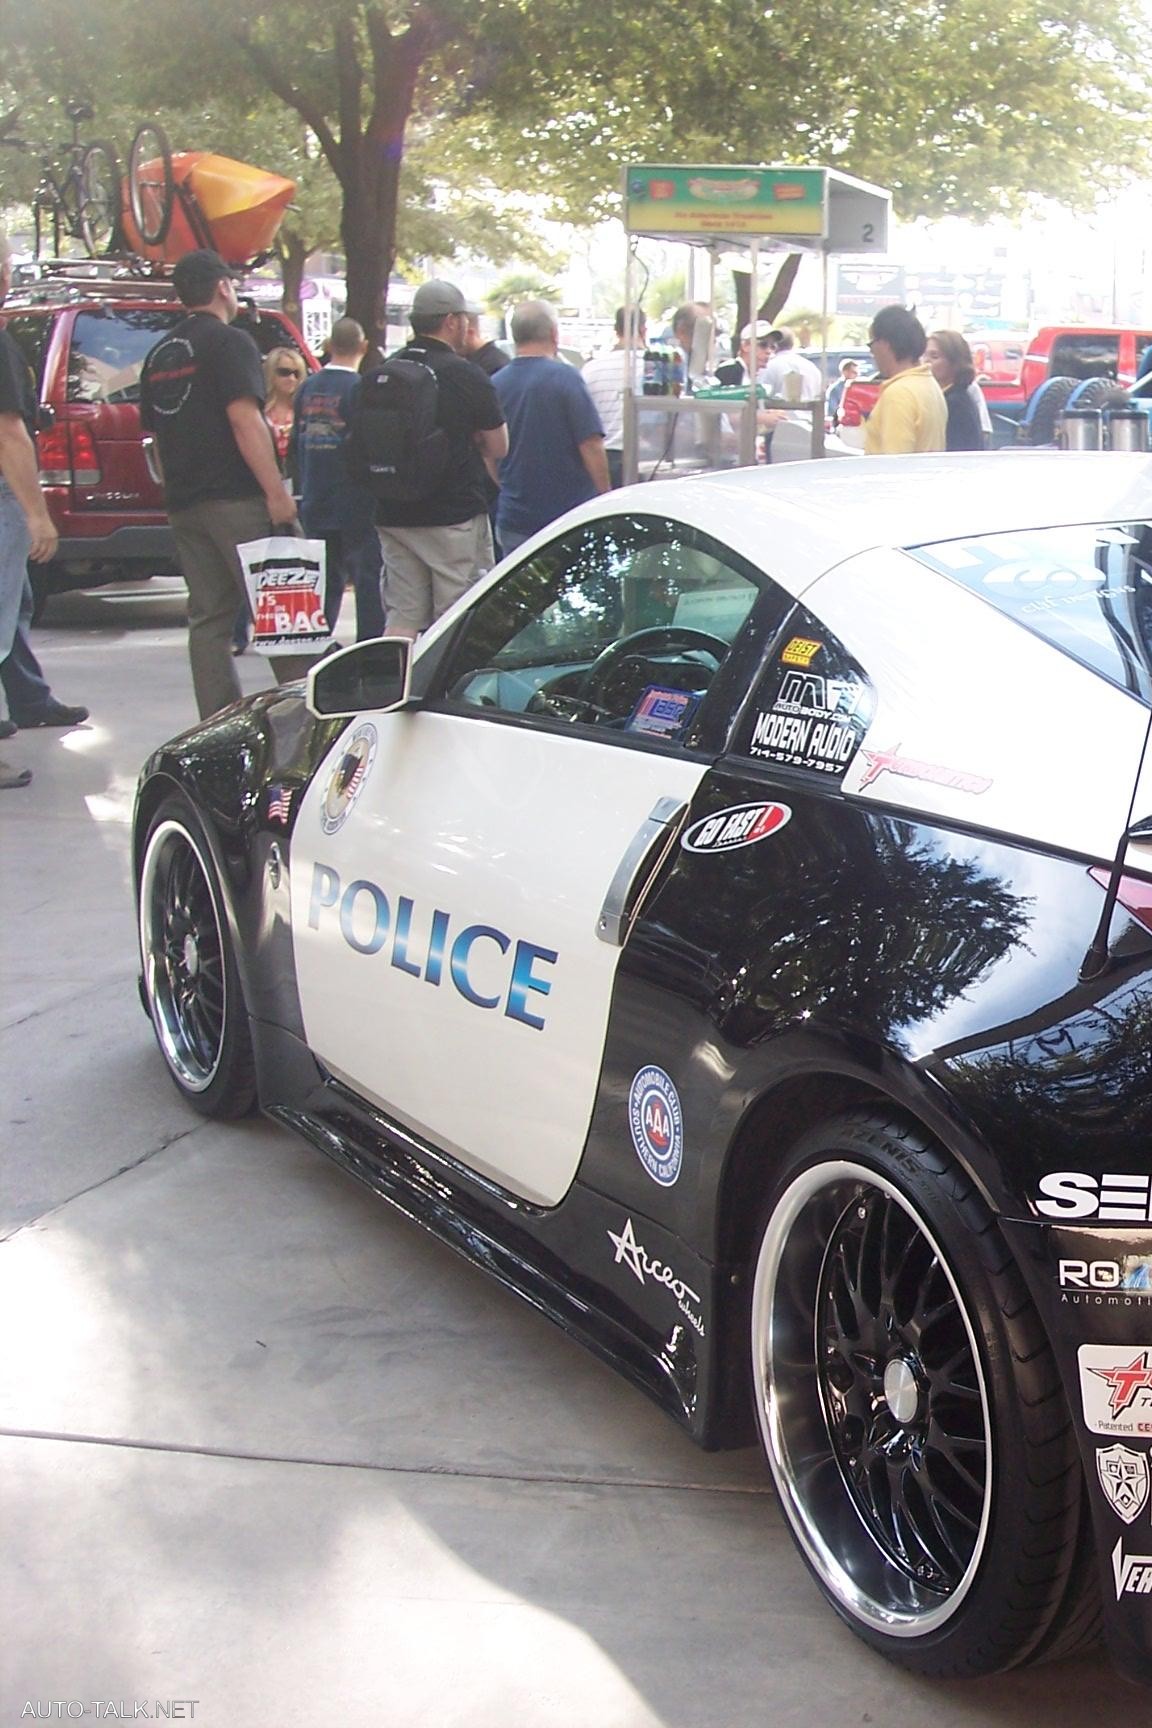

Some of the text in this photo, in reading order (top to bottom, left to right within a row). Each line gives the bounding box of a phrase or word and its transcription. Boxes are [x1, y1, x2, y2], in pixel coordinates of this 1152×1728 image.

[863, 224, 874, 242] 2
[752, 712, 856, 762] MODERN AUDIO
[750, 746, 845, 774] 714-579-7957
[308, 861, 560, 1032] POLICE
[645, 1104, 670, 1138] AAA
